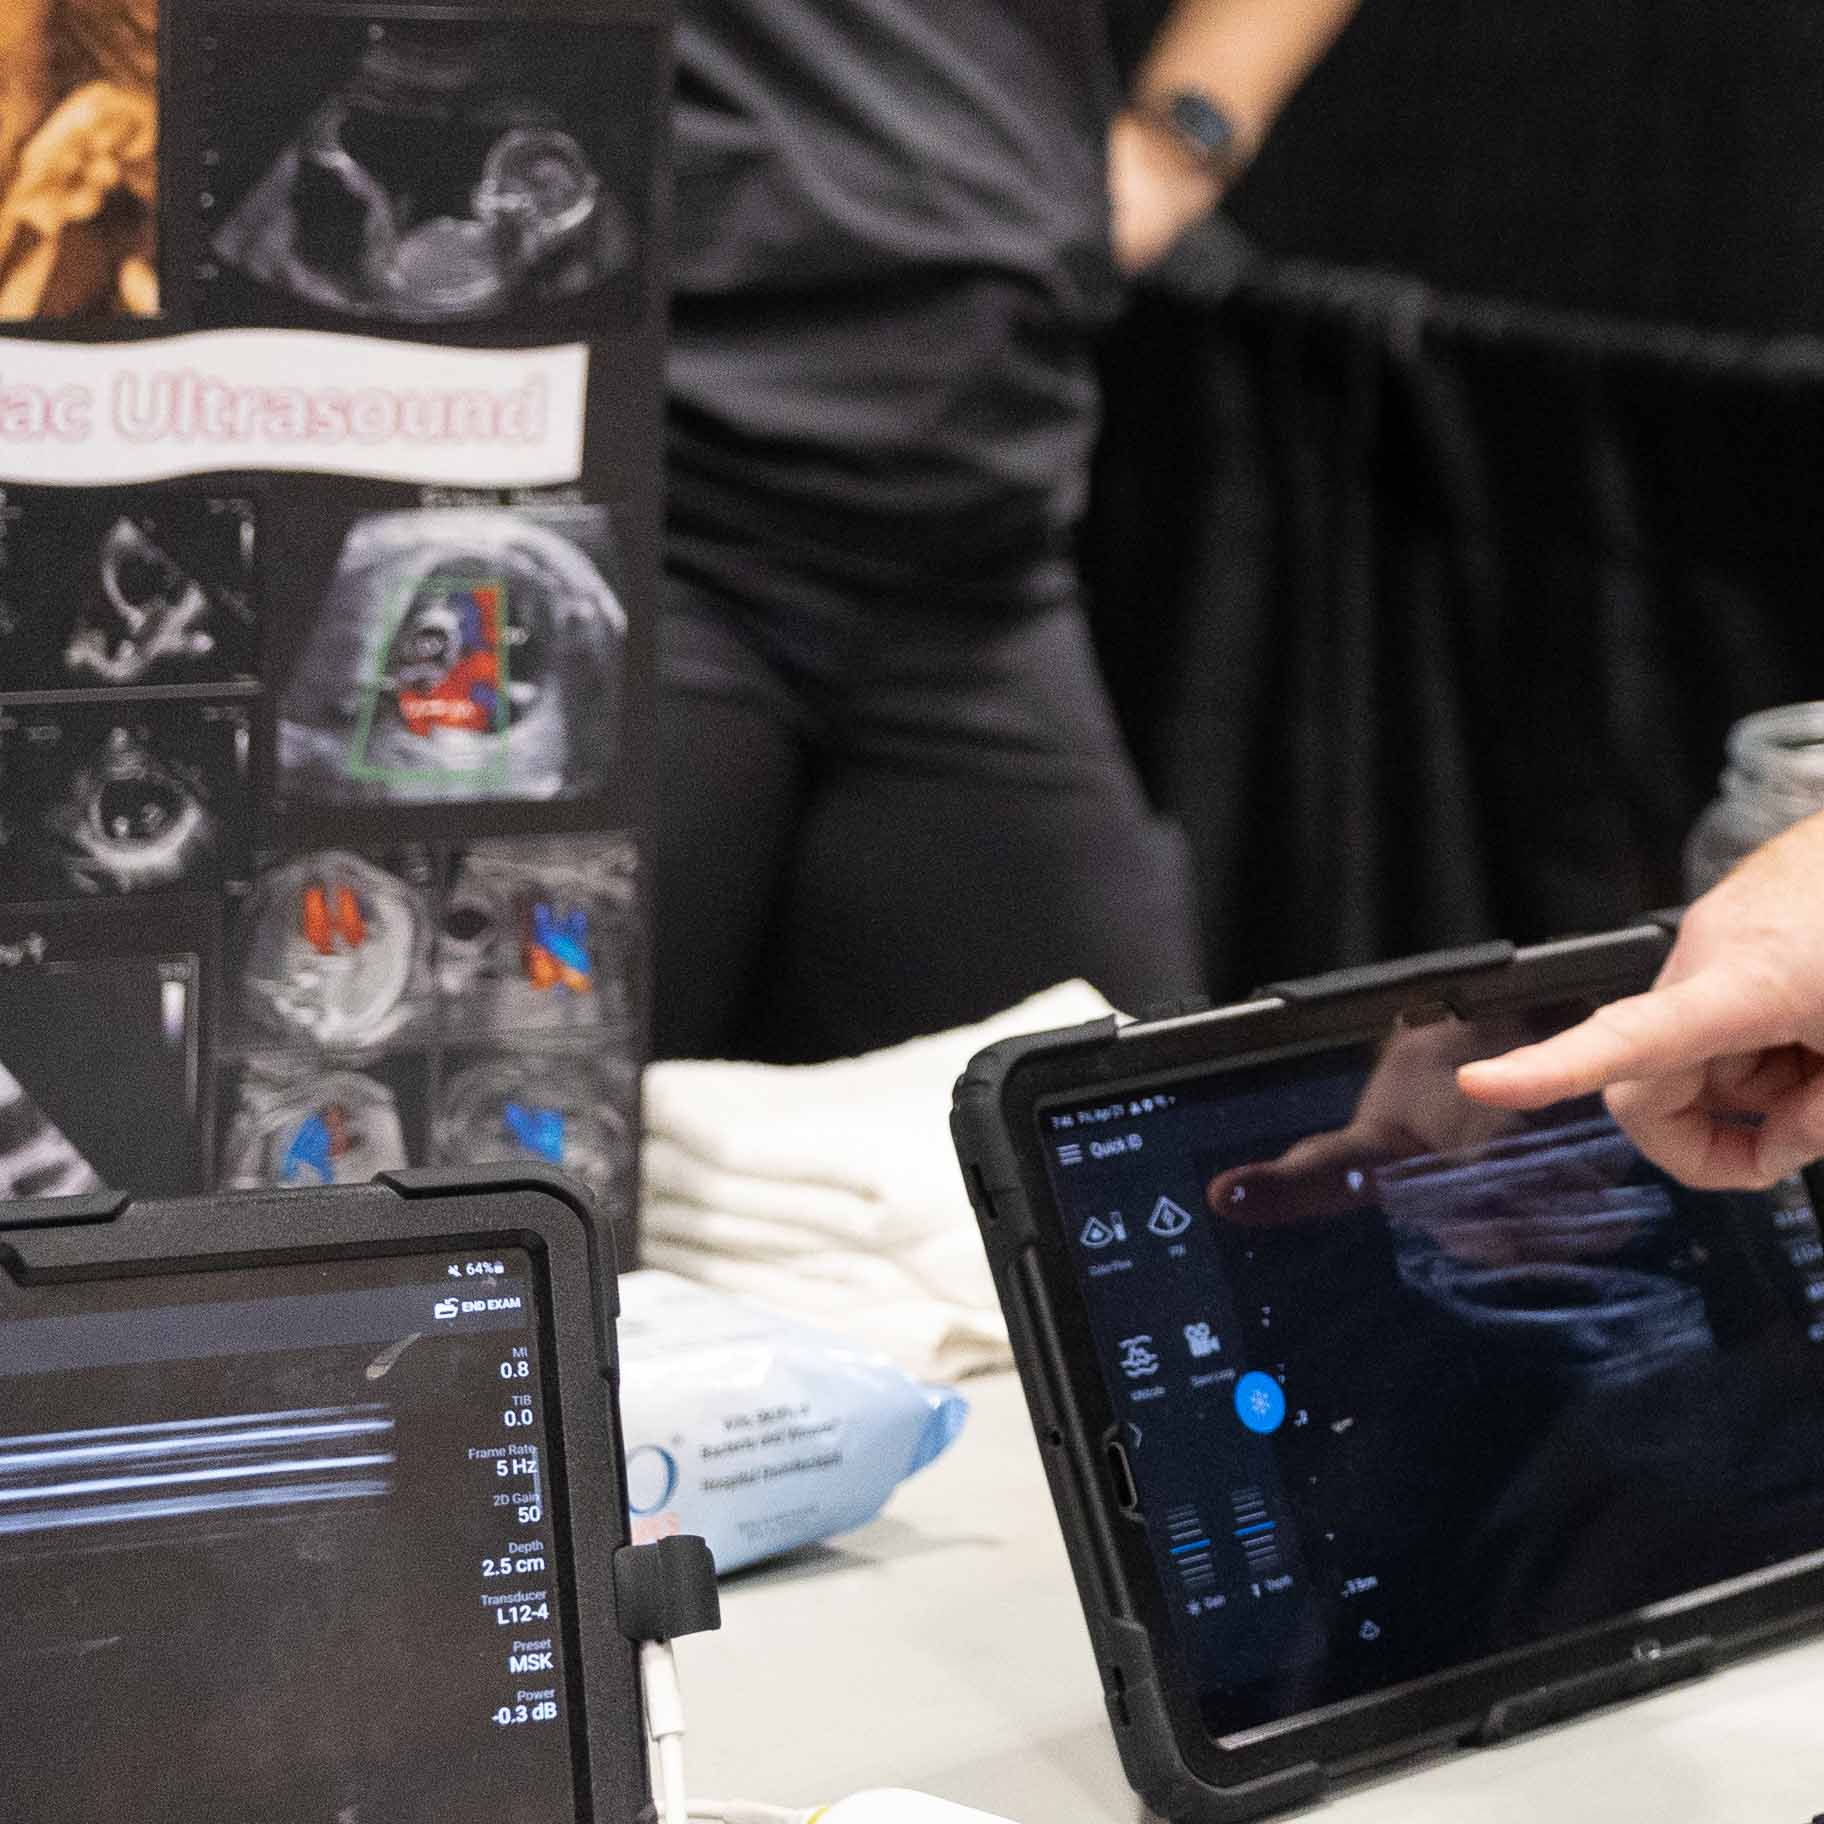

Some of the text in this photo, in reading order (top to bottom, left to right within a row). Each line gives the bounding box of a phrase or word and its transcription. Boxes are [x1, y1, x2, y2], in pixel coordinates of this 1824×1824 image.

[111, 368, 551, 446] Ultrasound
[465, 1261, 494, 1275] 64%
[462, 1297, 521, 1312] END EXAM
[512, 1346, 528, 1357] MI
[500, 1361, 529, 1379] 0.8
[512, 1394, 532, 1406] TIB
[504, 1409, 533, 1427] 0.0
[468, 1444, 537, 1460] Frame Rate
[496, 1458, 538, 1476] 5 Hz
[493, 1492, 540, 1507] 2D Gain
[518, 1506, 541, 1523] 50
[509, 1539, 545, 1554] Depth
[482, 1557, 545, 1577] 2.5 cm
[481, 1589, 547, 1607] Transducer
[497, 1603, 550, 1625] L12-4
[513, 1639, 552, 1654] Preset
[509, 1652, 554, 1674] MSK
[516, 1688, 556, 1703] Power
[492, 1702, 558, 1725] -0.3 dB
